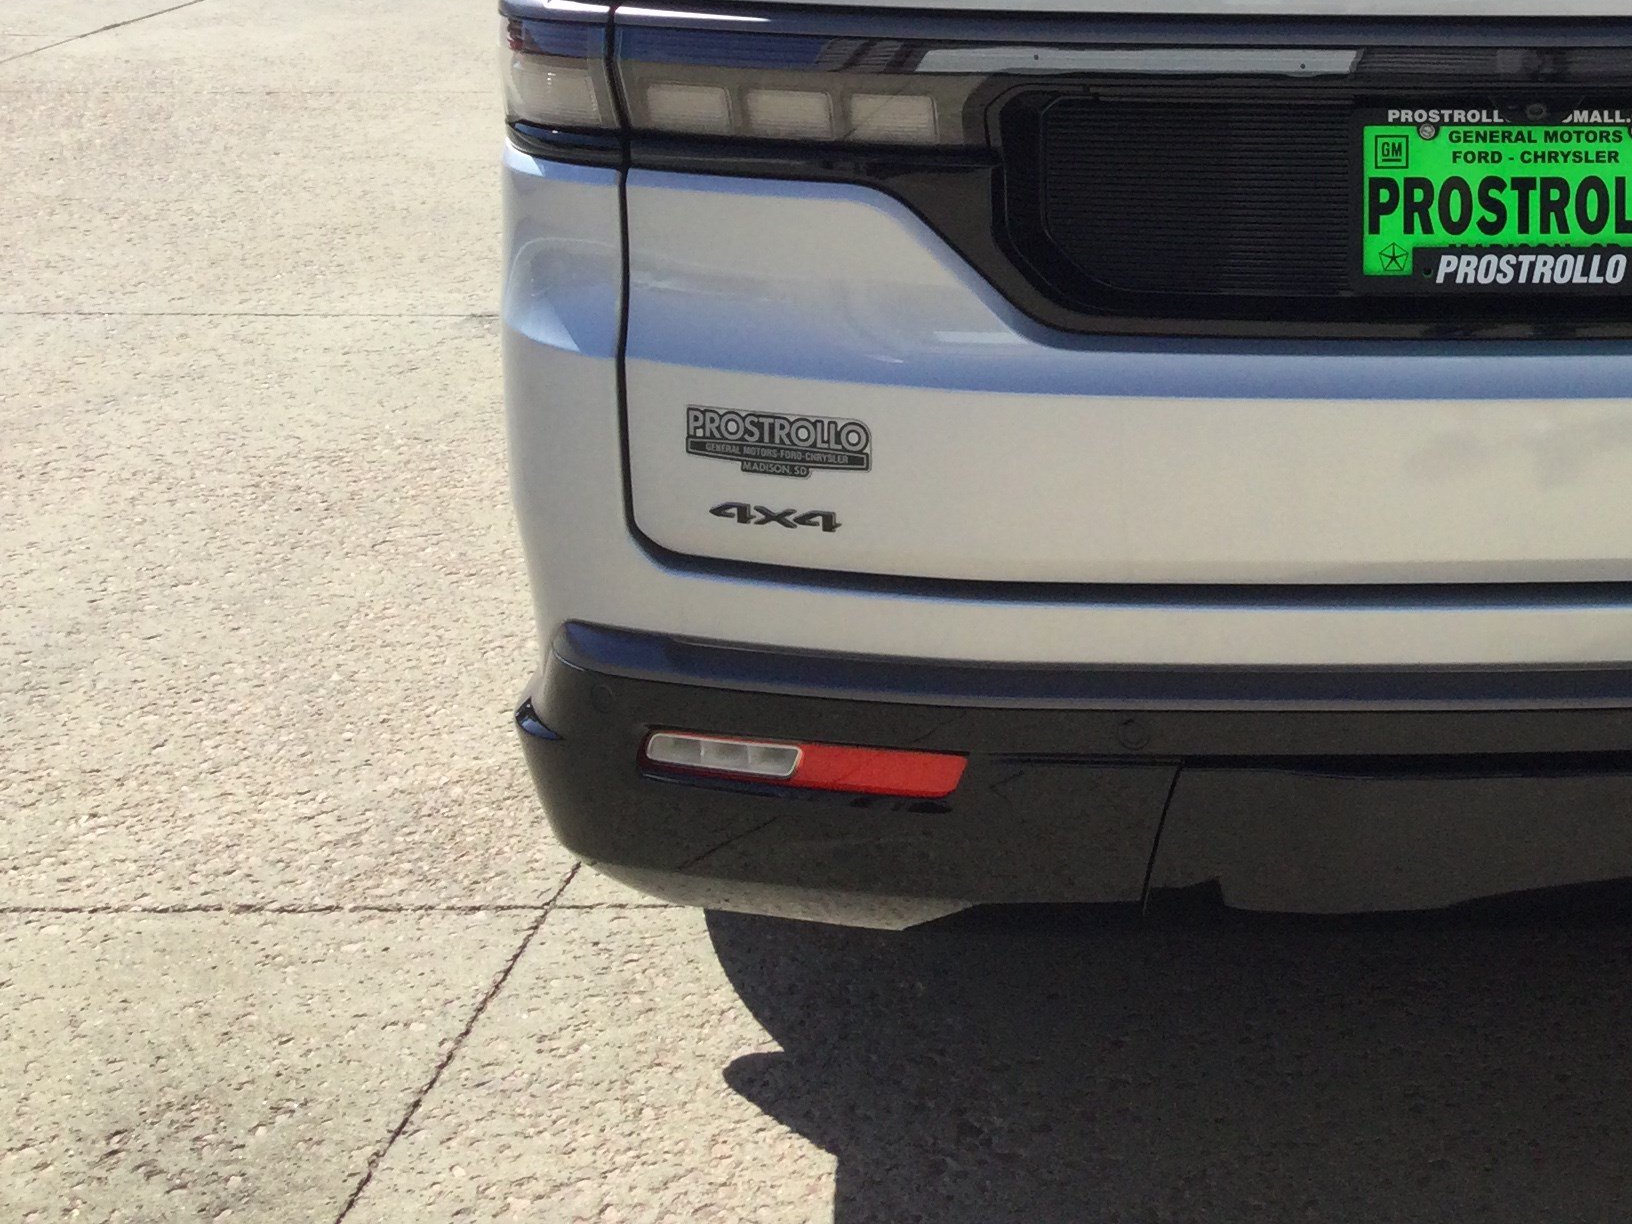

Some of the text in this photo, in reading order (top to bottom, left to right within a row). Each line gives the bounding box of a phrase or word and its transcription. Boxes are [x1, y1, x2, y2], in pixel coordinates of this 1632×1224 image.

[1387, 109, 1511, 123] PROSTROLL
[1448, 130, 1623, 144] GENERAL MOTORS
[1381, 141, 1403, 158] GM
[1452, 150, 1503, 164] FORD
[1519, 150, 1620, 164] CHRYSLER
[1436, 254, 1627, 284] PROSTROLLO
[687, 408, 868, 453] PROSTROLLO
[705, 443, 741, 455] GENERAL
